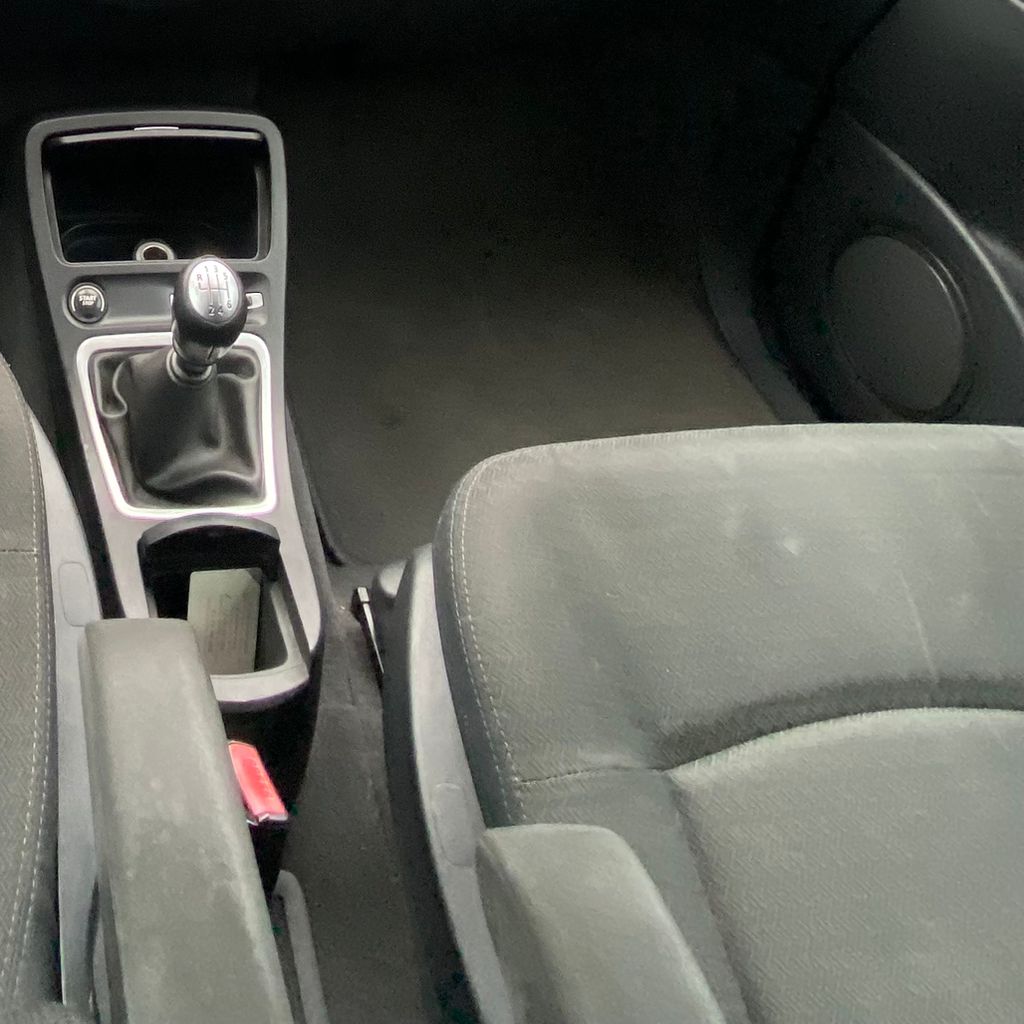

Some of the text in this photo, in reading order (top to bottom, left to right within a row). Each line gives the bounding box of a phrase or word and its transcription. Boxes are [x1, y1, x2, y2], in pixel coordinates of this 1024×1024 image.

[196, 273, 203, 282] R
[208, 304, 215, 315] 2
[226, 299, 233, 310] 6
